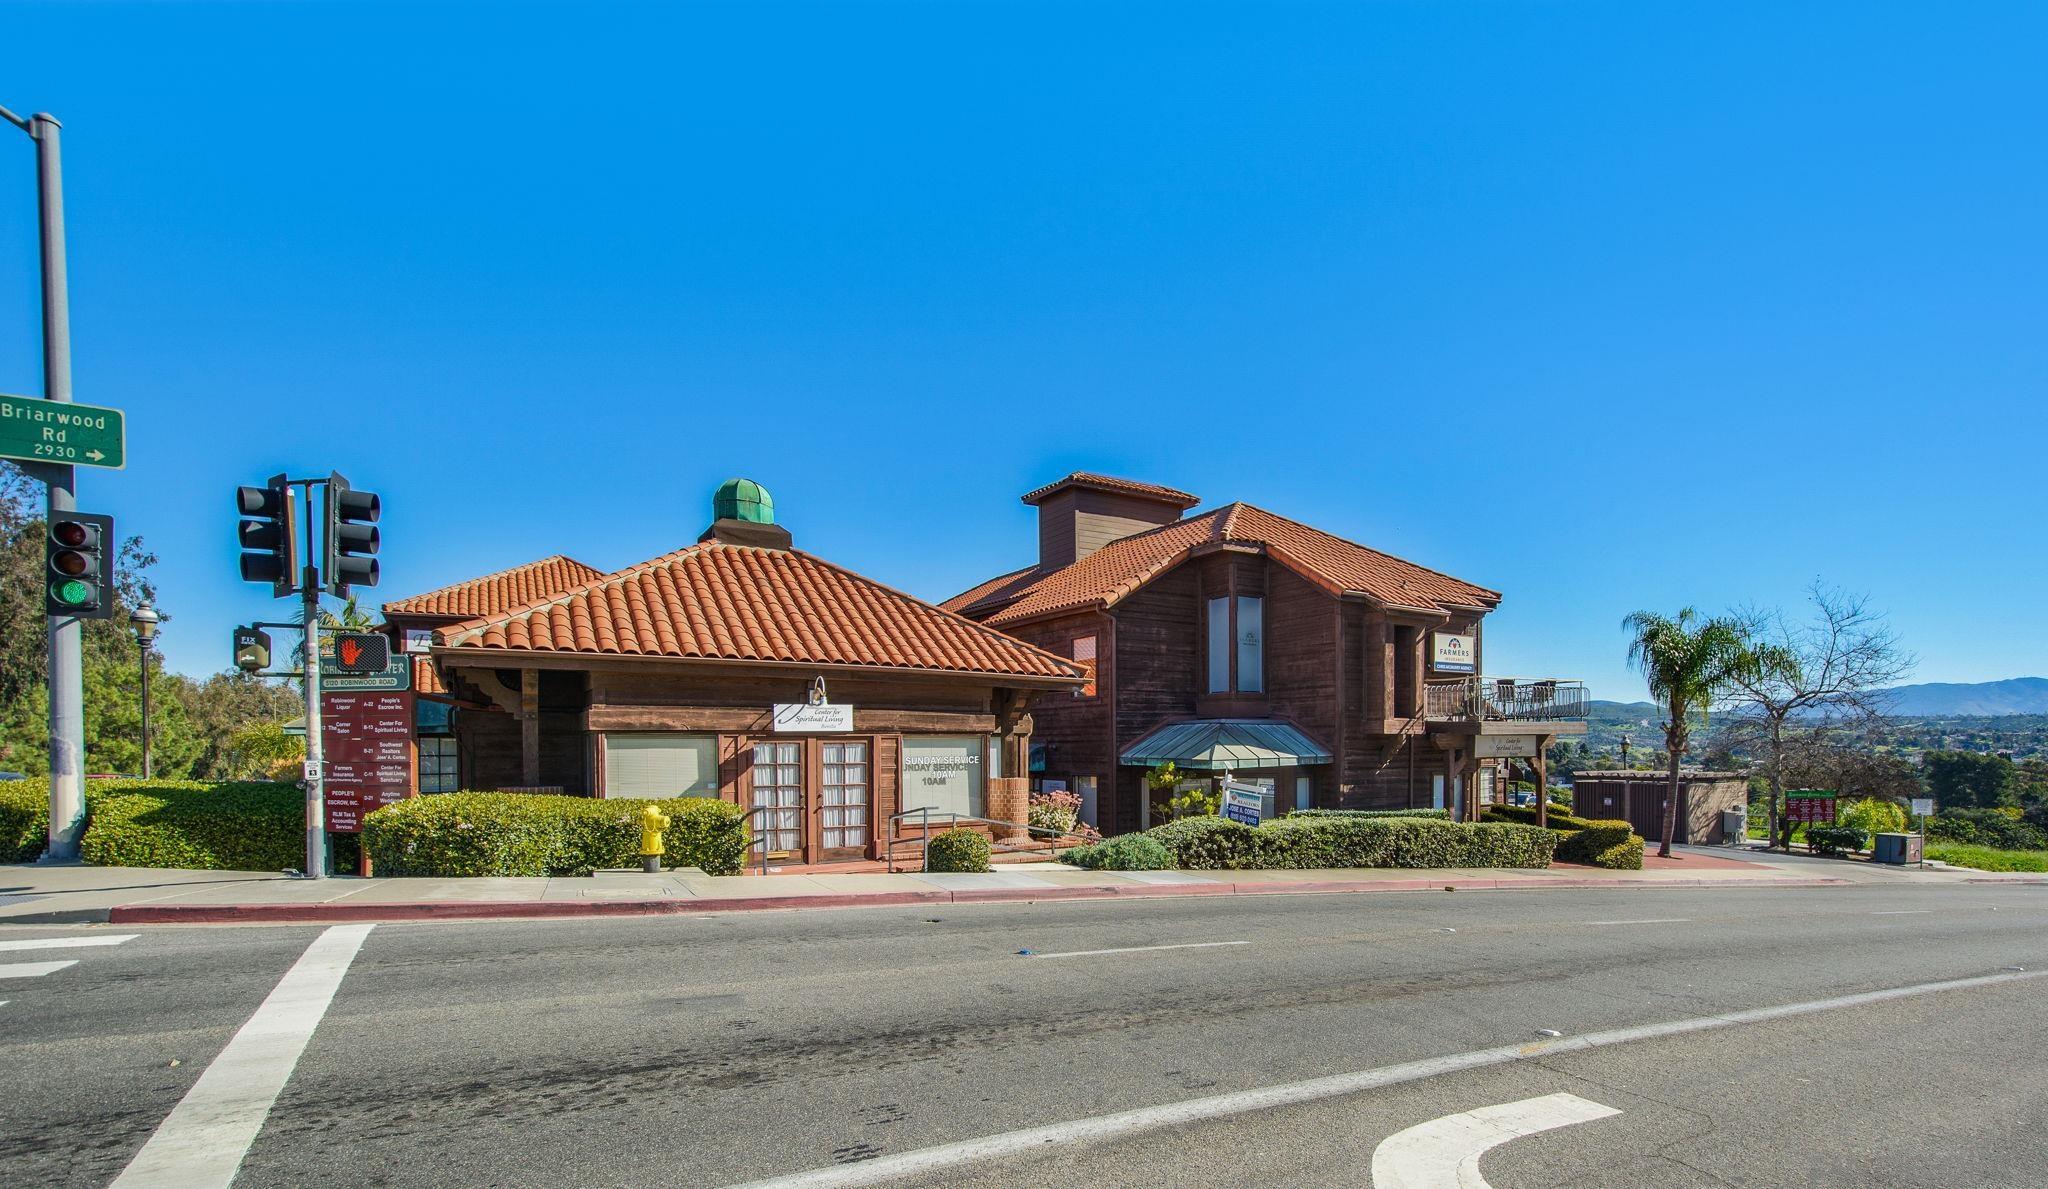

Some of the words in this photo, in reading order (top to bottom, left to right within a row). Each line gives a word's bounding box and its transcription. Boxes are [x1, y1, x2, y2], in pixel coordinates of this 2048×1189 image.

[1, 403, 105, 430] Briarwood
[42, 427, 67, 443] Rd
[34, 443, 76, 459] 2930
[1440, 648, 1470, 657] FARMERS
[340, 678, 378, 686] ROBINWOOD
[795, 715, 823, 725] Spiritual
[824, 716, 844, 726] Living
[393, 726, 408, 734] Living
[905, 756, 942, 765] SUNDAY
[943, 755, 980, 764] SERVICE
[932, 770, 956, 779] 10AM
